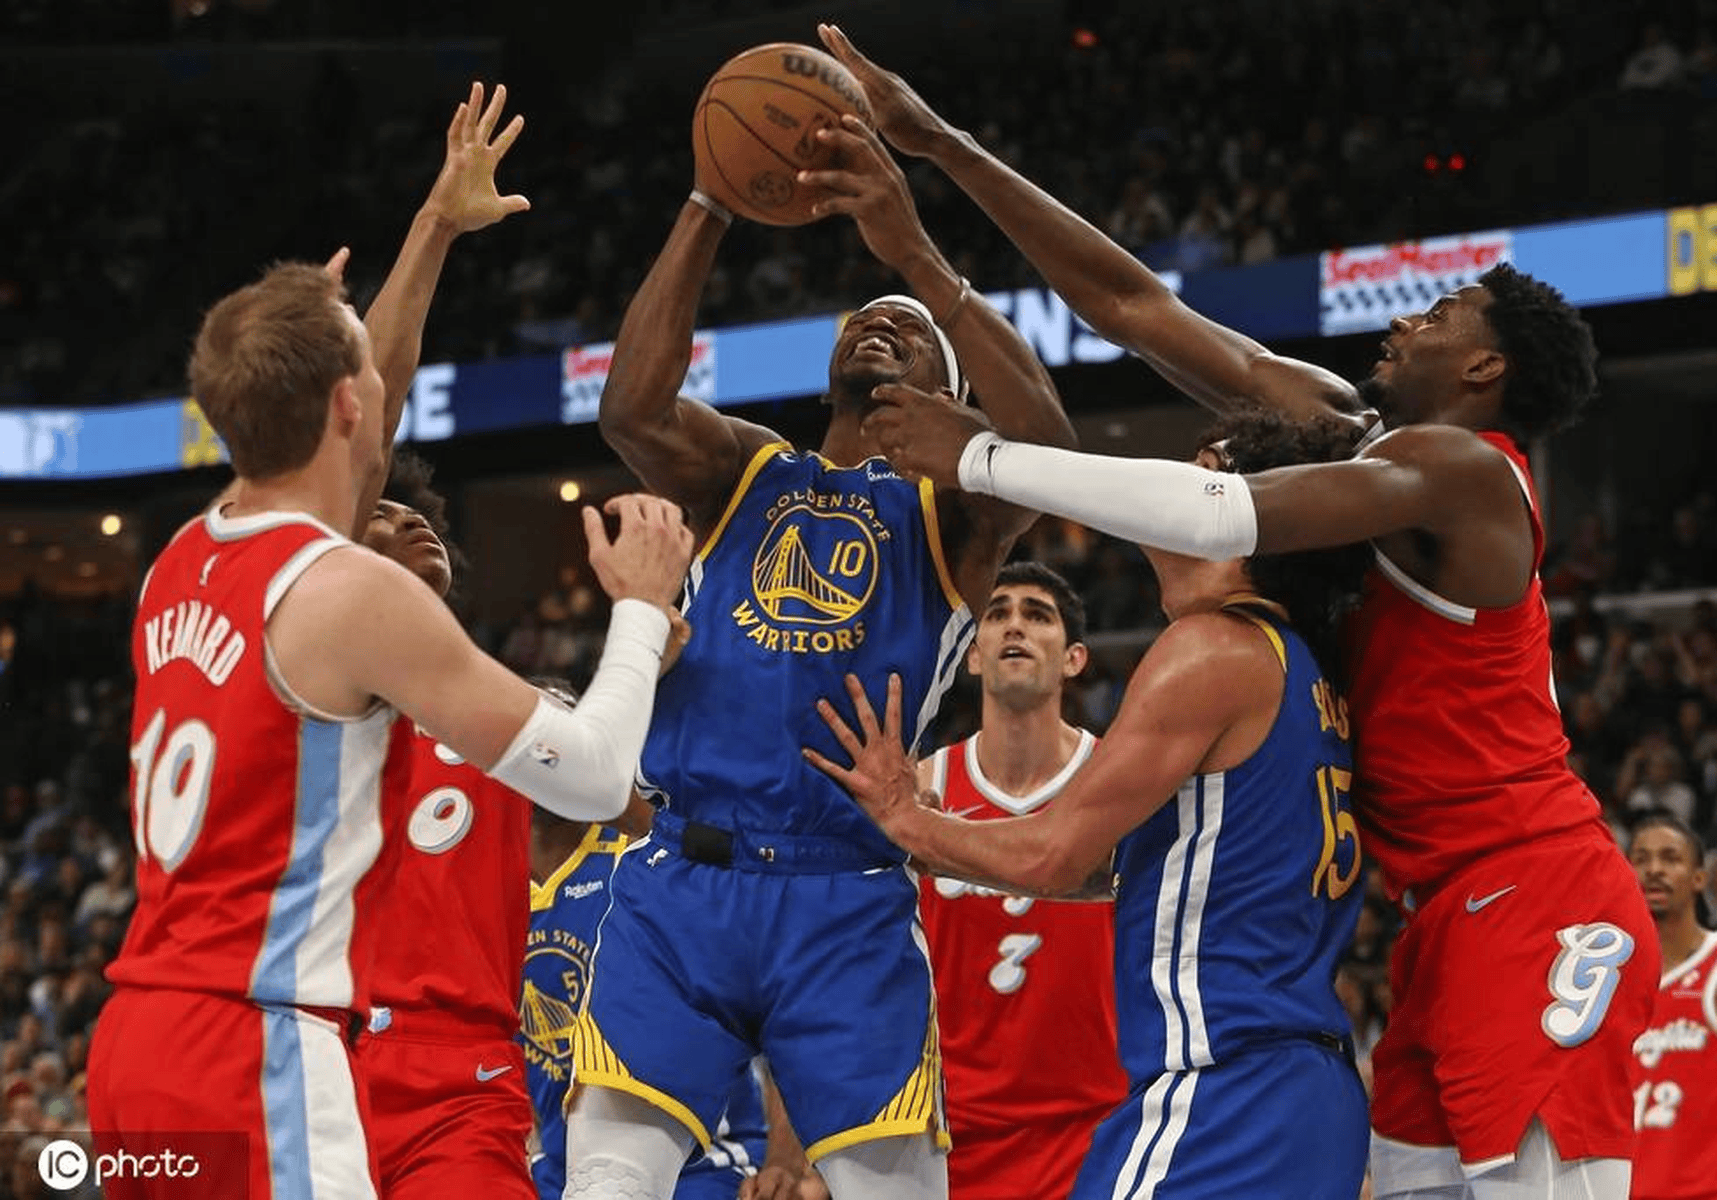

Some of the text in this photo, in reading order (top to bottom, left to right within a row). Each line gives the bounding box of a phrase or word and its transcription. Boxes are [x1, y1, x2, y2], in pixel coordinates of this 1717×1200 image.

[766, 487, 892, 542] GOLDEN STATE
[828, 540, 867, 577] 10
[732, 599, 866, 653] WARRIORS
[130, 707, 217, 875] 10
[1311, 765, 1362, 900] 15
[562, 970, 579, 1003] 5
[1541, 922, 1635, 1049] G
[1632, 1080, 1684, 1133] 12
